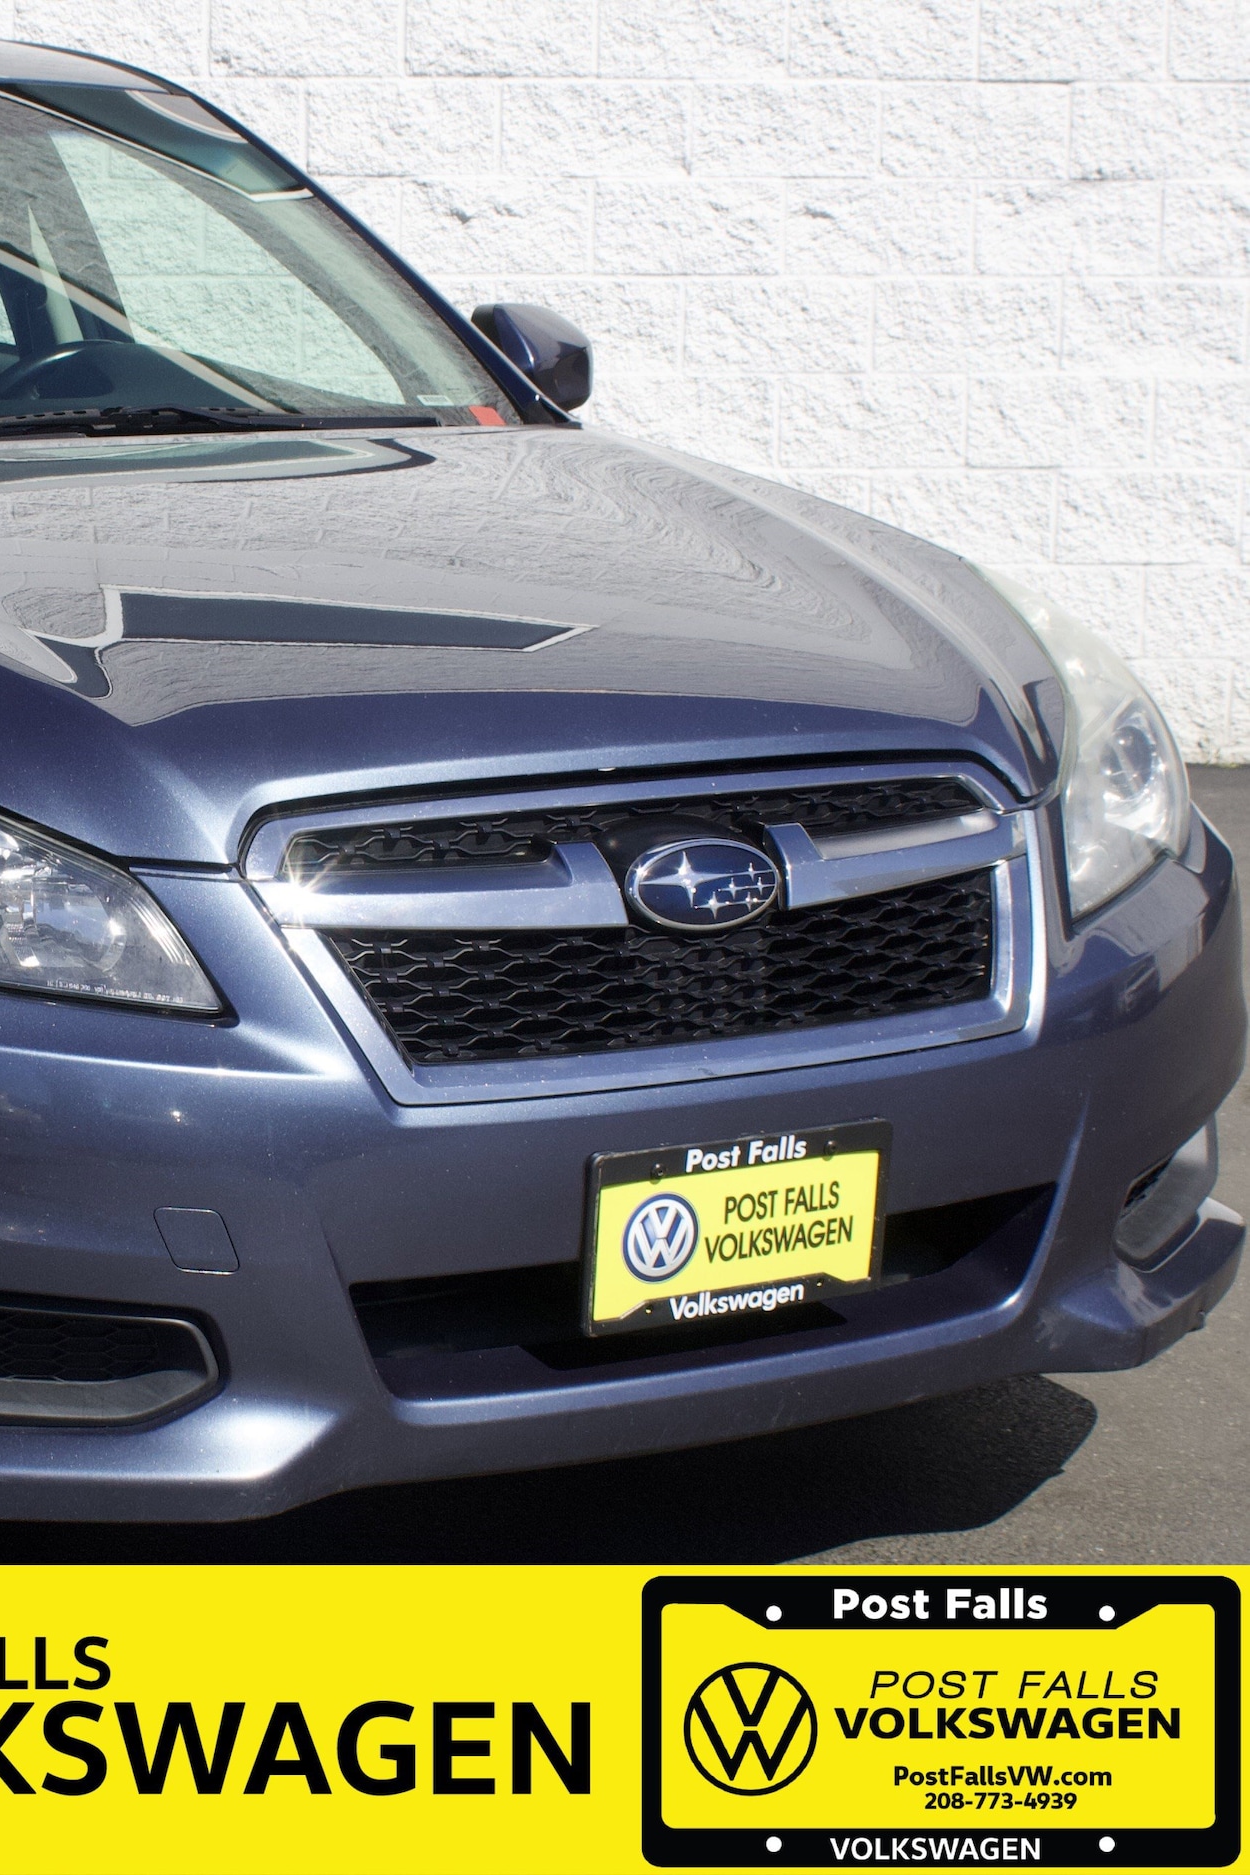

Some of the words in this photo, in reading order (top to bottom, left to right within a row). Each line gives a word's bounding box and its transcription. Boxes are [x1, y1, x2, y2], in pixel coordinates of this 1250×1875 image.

[685, 1145, 740, 1173] Post
[747, 1135, 807, 1166] Falls
[724, 1190, 778, 1225] POST
[784, 1181, 841, 1216] FALLS
[704, 1215, 855, 1264] VOLKSWAGEN
[670, 1283, 805, 1321] Volkswagen
